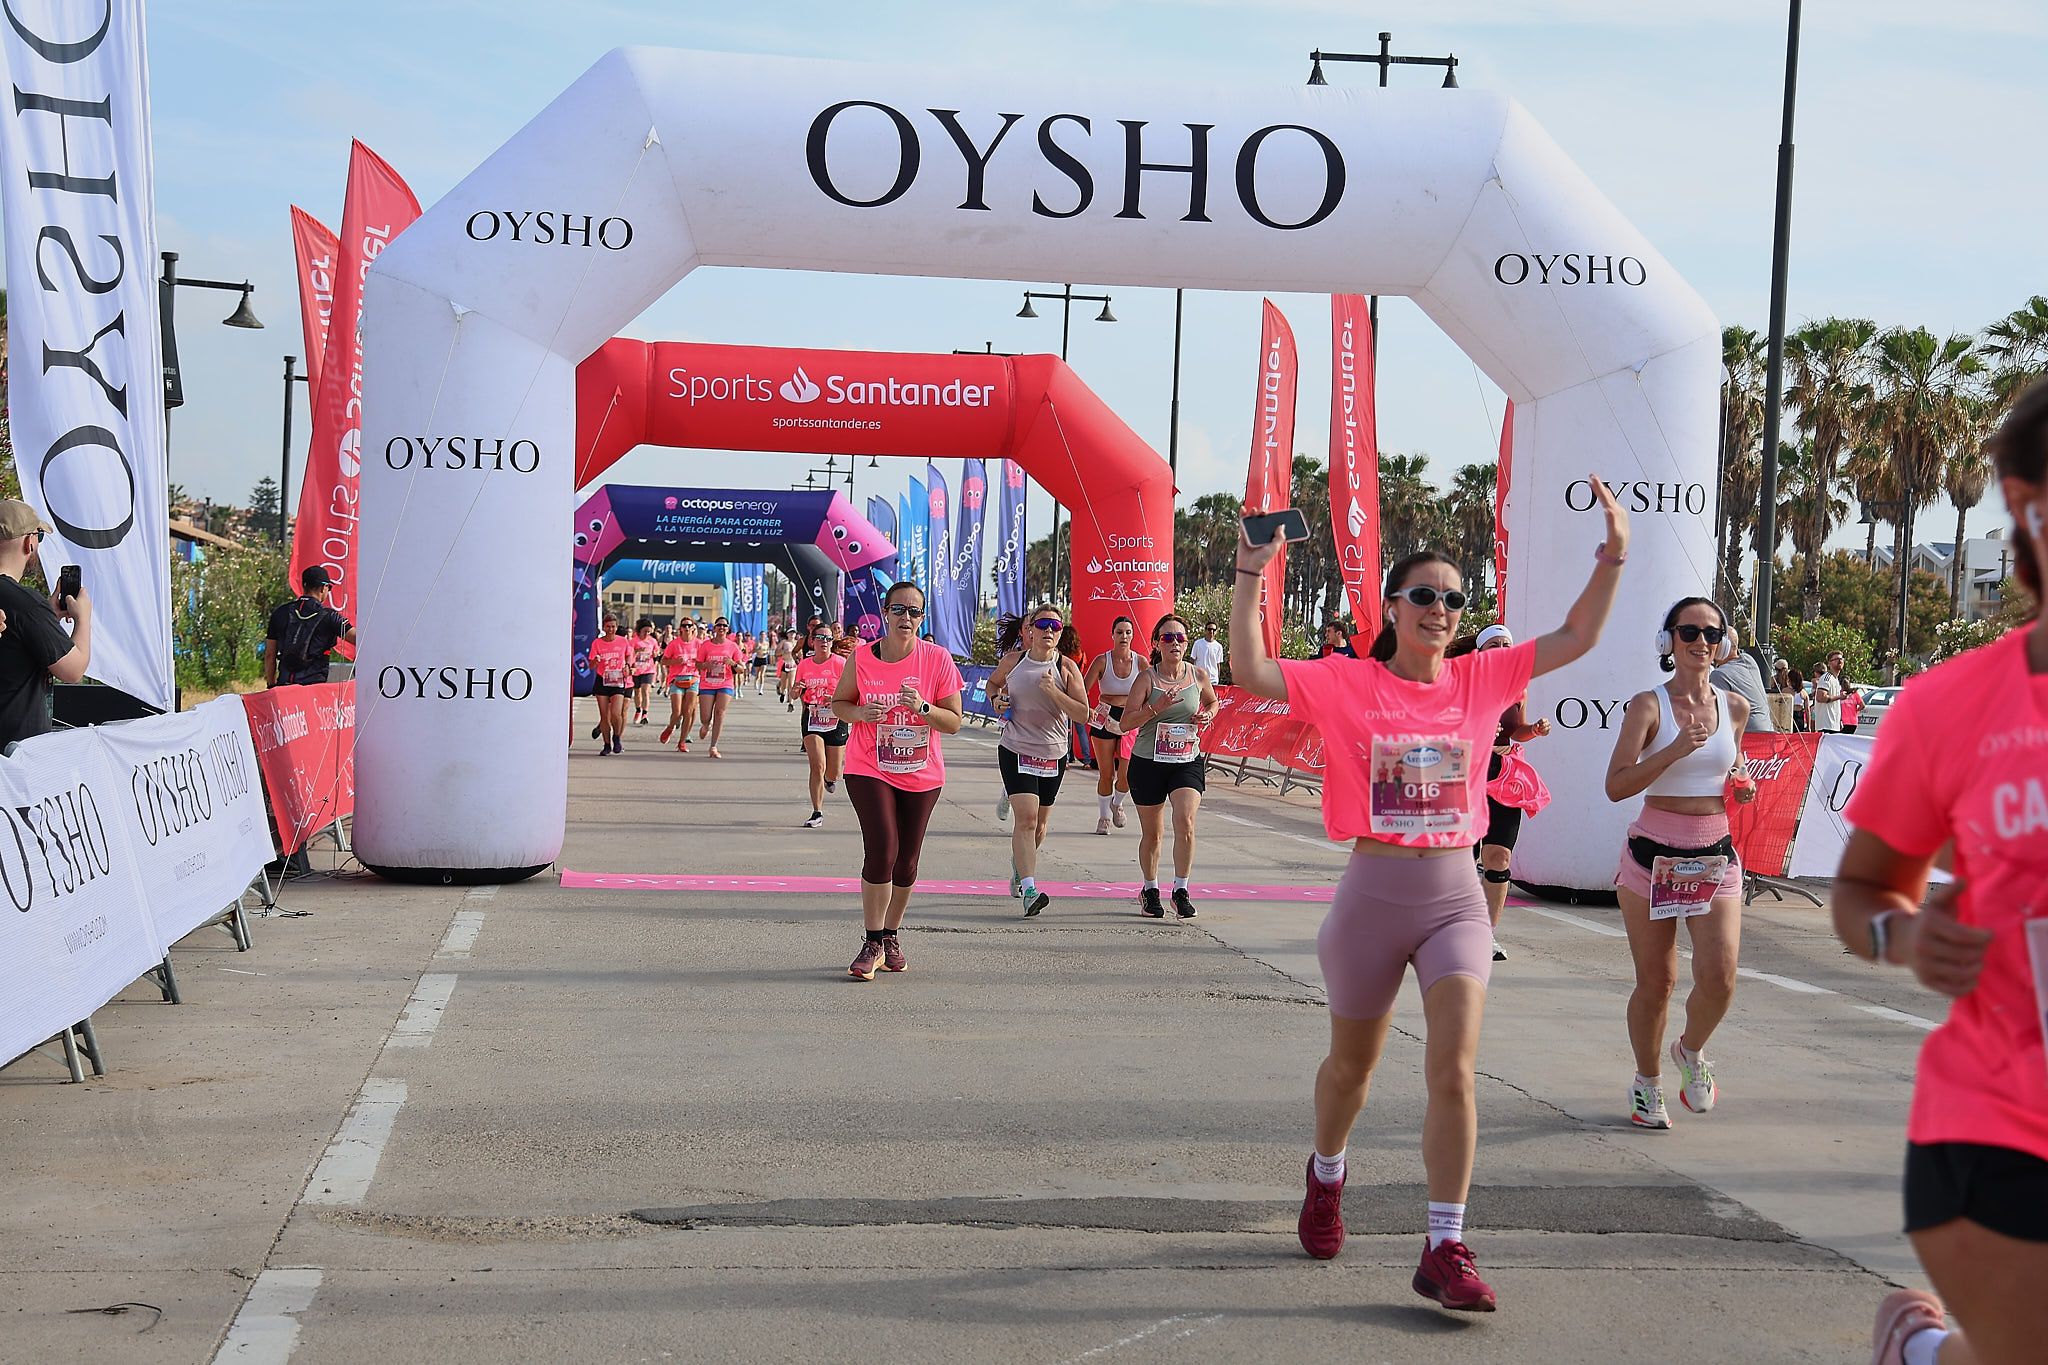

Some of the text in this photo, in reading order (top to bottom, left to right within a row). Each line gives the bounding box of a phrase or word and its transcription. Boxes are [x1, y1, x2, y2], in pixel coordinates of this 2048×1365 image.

[806, 99, 1347, 231] OYSHO
[465, 210, 634, 251] OYSHO
[1493, 253, 1648, 287] OYSHO
[668, 366, 995, 407] Sports Santander
[772, 416, 881, 431] sportssantander.es
[385, 436, 541, 473] OYSHO
[681, 498, 778, 515] octopus energy
[656, 515, 781, 527] LA ENERGÍA PARA CORRER
[664, 525, 677, 533] LA
[679, 526, 734, 535] VELOCIDAD
[750, 528, 762, 536] LA
[764, 528, 783, 536] LUZ
[1108, 533, 1154, 551] Sports
[641, 559, 696, 579] Marlene
[1104, 558, 1170, 574] Santander
[378, 665, 533, 700] OYSHO
[1365, 709, 1407, 721] OYSHO
[893, 747, 914, 756] 016
[132, 748, 212, 847] OYSHO
[1404, 782, 1440, 798] 016
[0, 782, 110, 914] OYSHO
[1672, 881, 1700, 892] 016
